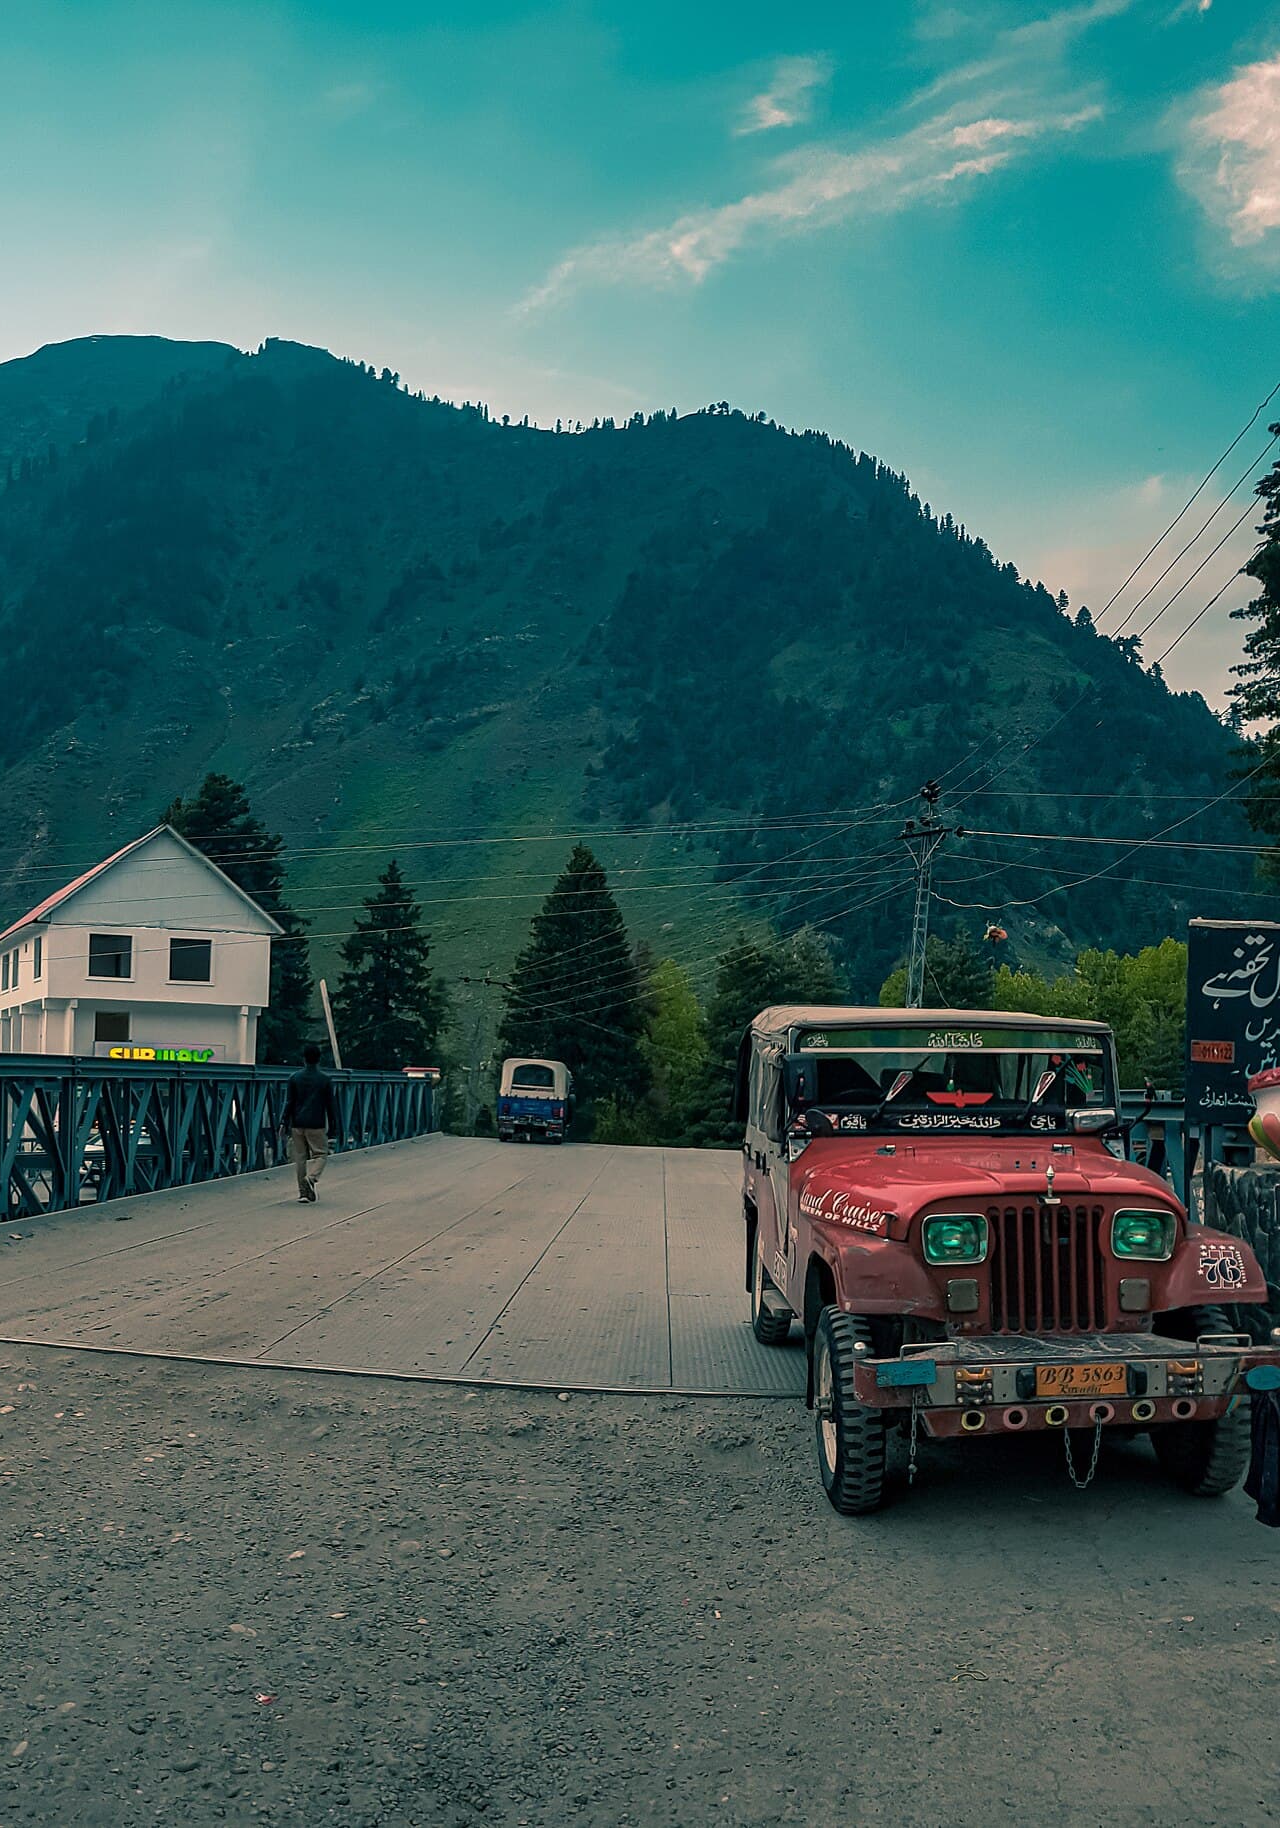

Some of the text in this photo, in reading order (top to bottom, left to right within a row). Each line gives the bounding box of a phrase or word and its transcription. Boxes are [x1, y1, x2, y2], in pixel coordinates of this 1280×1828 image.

[832, 1190, 886, 1225] Cruiser
[825, 1212, 841, 1221] OF
[842, 1217, 880, 1232] HILLS
[1200, 1256, 1242, 1284] 76
[1080, 1366, 1124, 1383] 5863
